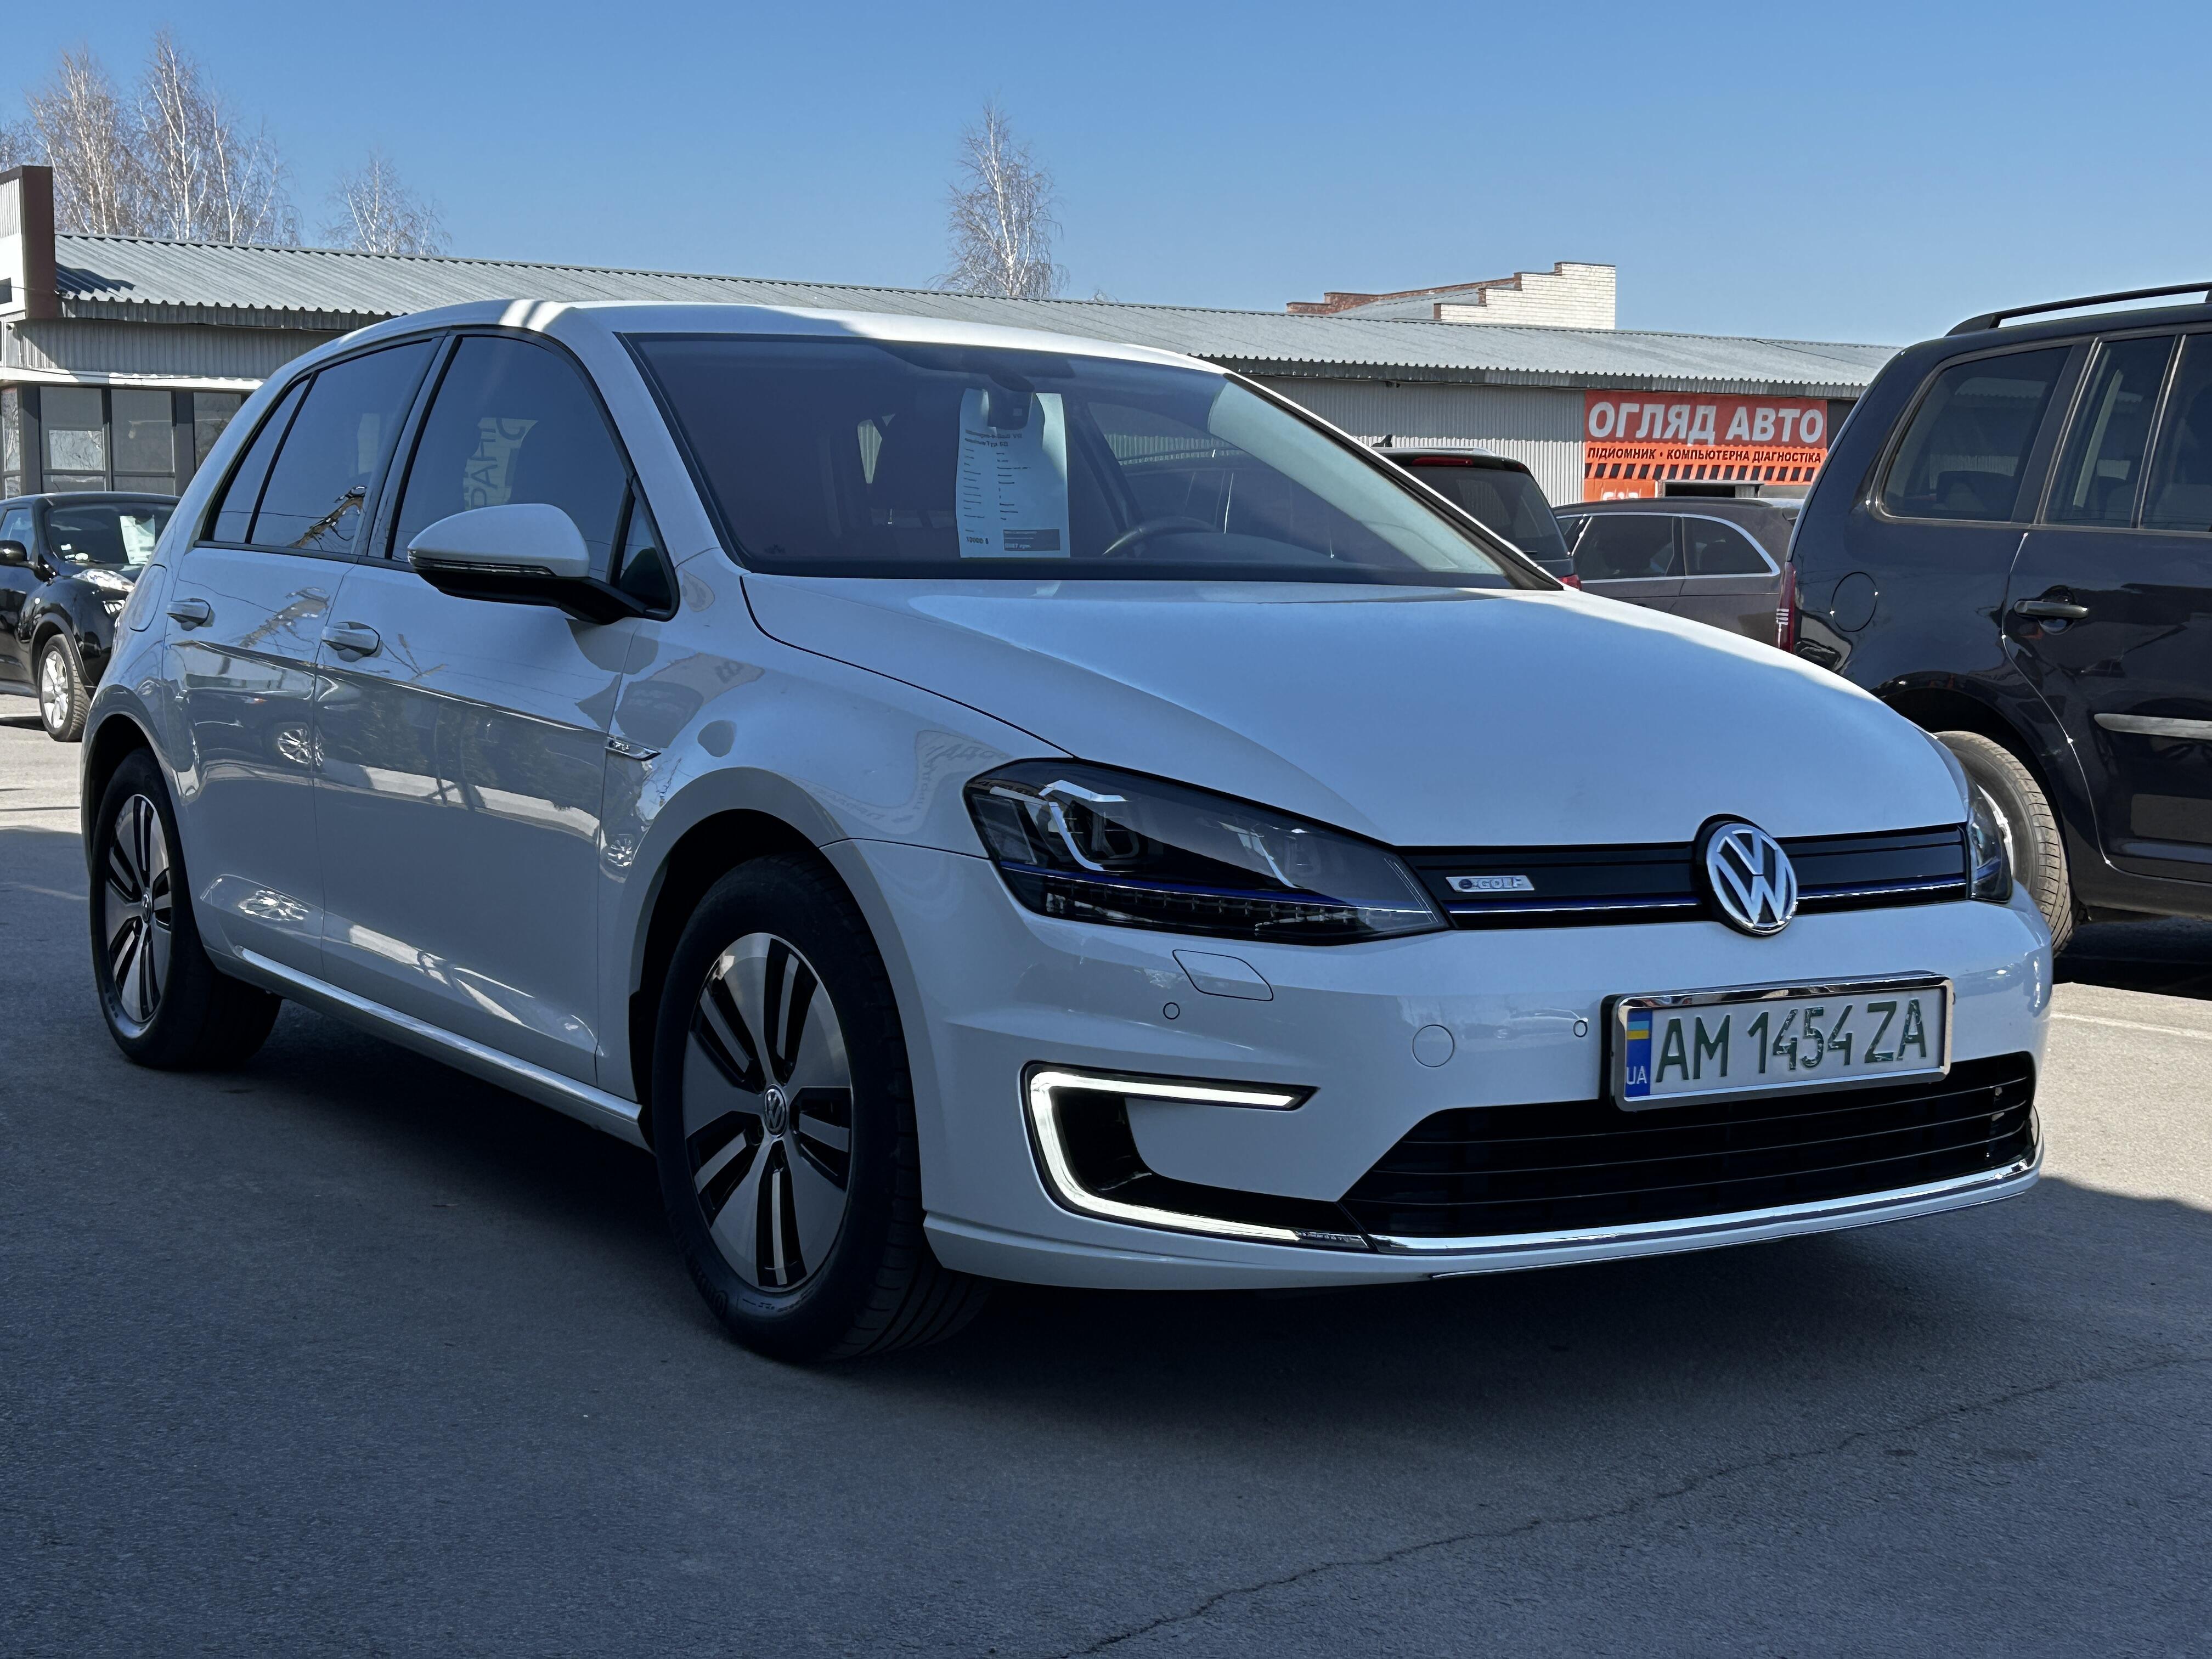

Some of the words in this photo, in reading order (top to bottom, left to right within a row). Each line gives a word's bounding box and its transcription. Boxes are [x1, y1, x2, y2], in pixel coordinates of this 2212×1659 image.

[1588, 402, 1716, 446] ОГЛЯД
[1725, 407, 1824, 443] АВТО
[1656, 1014, 1731, 1084] AM
[1747, 1005, 1853, 1074] 1454
[1865, 998, 1927, 1064] ZA
[1626, 1065, 1648, 1085] UA
